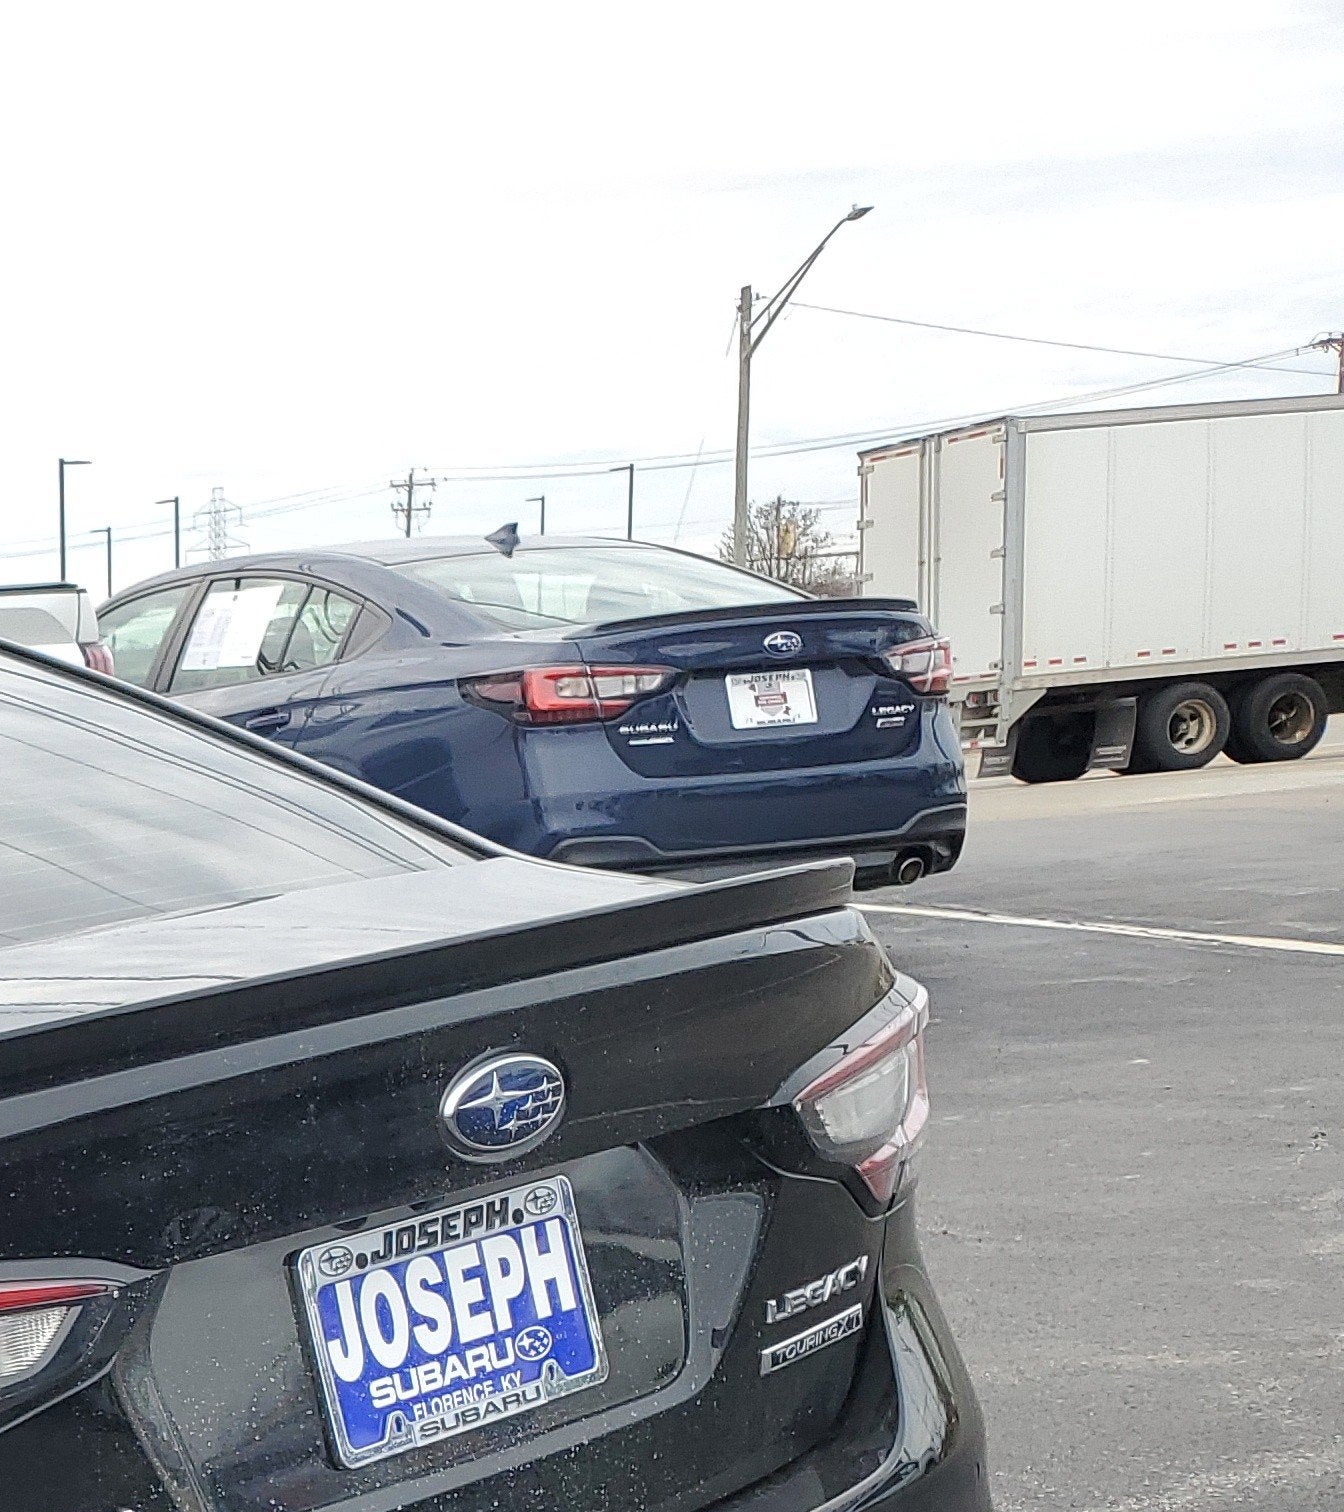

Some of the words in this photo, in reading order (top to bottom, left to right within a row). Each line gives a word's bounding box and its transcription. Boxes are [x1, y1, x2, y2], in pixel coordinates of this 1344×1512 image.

[618, 719, 679, 735] SUBARU
[872, 704, 915, 716] LEGACY
[370, 1197, 510, 1264] JOSEPH
[327, 1218, 577, 1383] JOSEPH
[369, 1338, 516, 1409] SUBARU
[500, 1369, 522, 1393] KY
[418, 1384, 542, 1439] SUBARU
